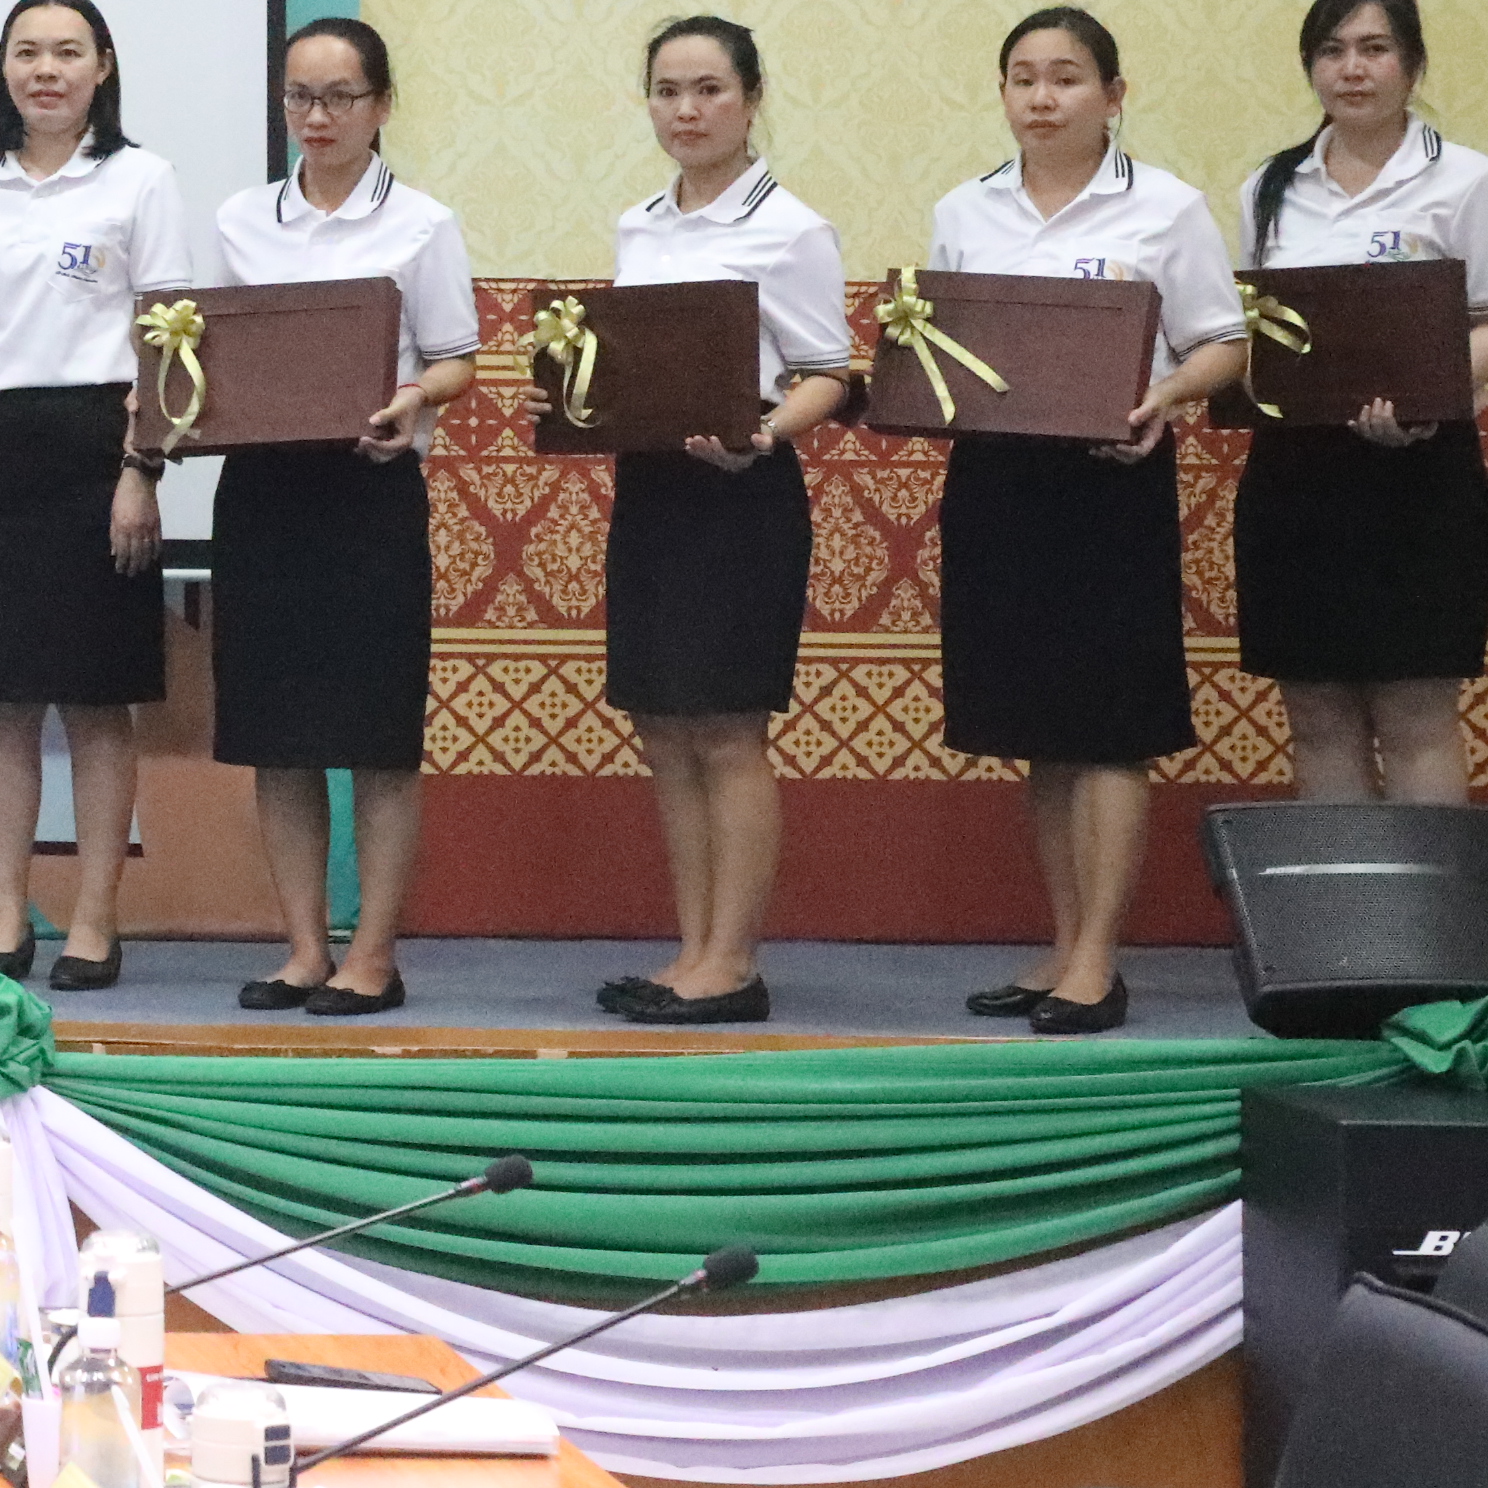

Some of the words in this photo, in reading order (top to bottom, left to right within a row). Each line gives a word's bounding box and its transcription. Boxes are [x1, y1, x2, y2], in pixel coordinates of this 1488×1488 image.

[57, 242, 92, 270] 51
[1366, 230, 1401, 258] 51
[1074, 257, 1106, 280] 51
[1392, 1230, 1471, 1256] B
